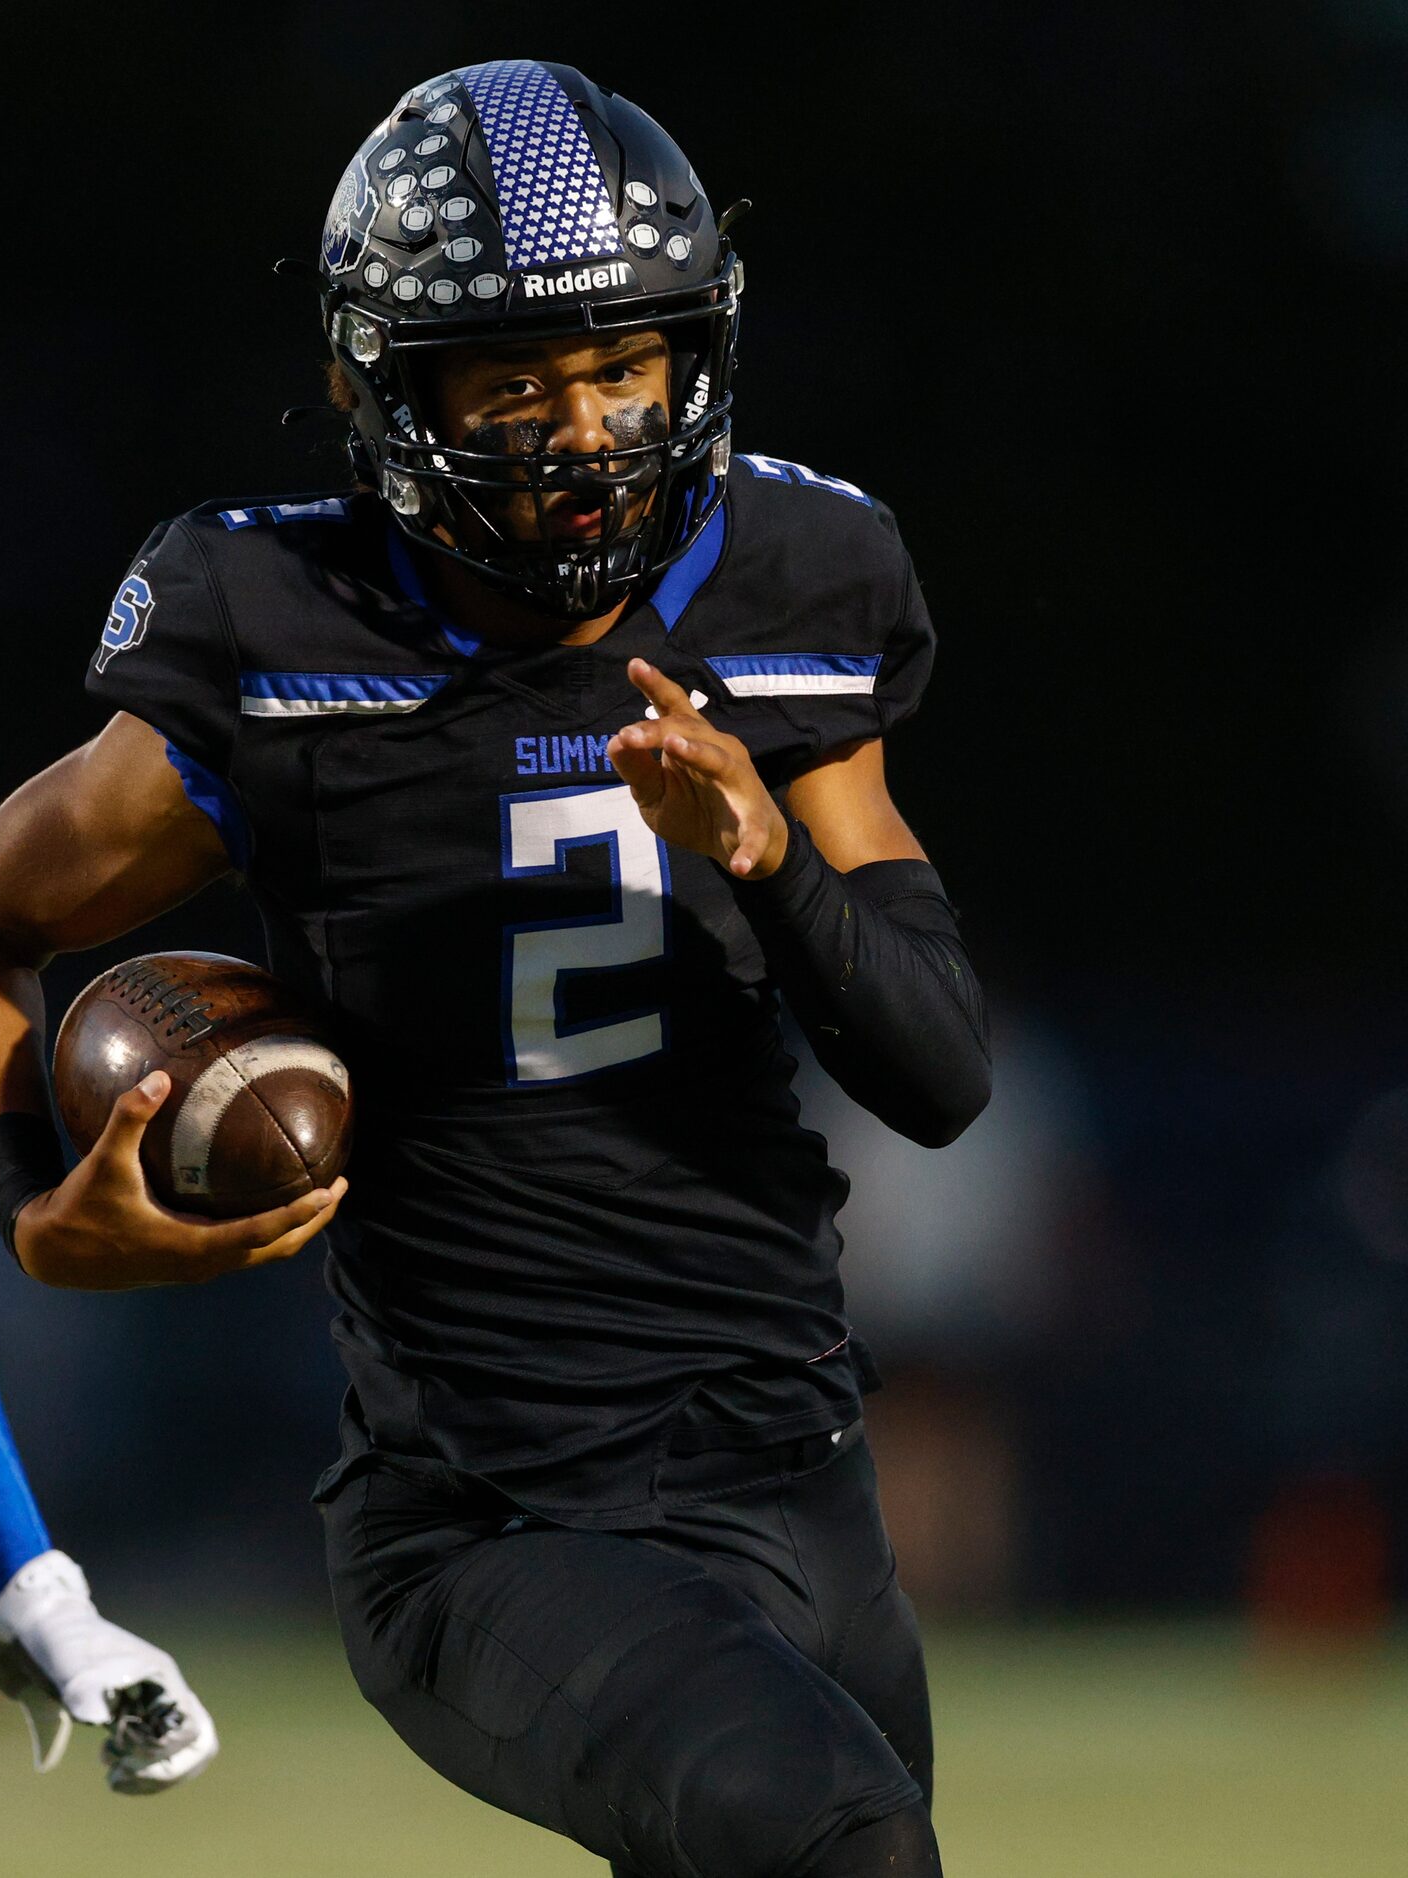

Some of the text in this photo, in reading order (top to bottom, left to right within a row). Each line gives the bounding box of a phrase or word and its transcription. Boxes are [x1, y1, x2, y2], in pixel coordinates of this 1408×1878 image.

[523, 262, 627, 298] Riddell
[101, 574, 152, 650] S
[515, 734, 613, 775] SUMM
[499, 783, 673, 1089] 2
